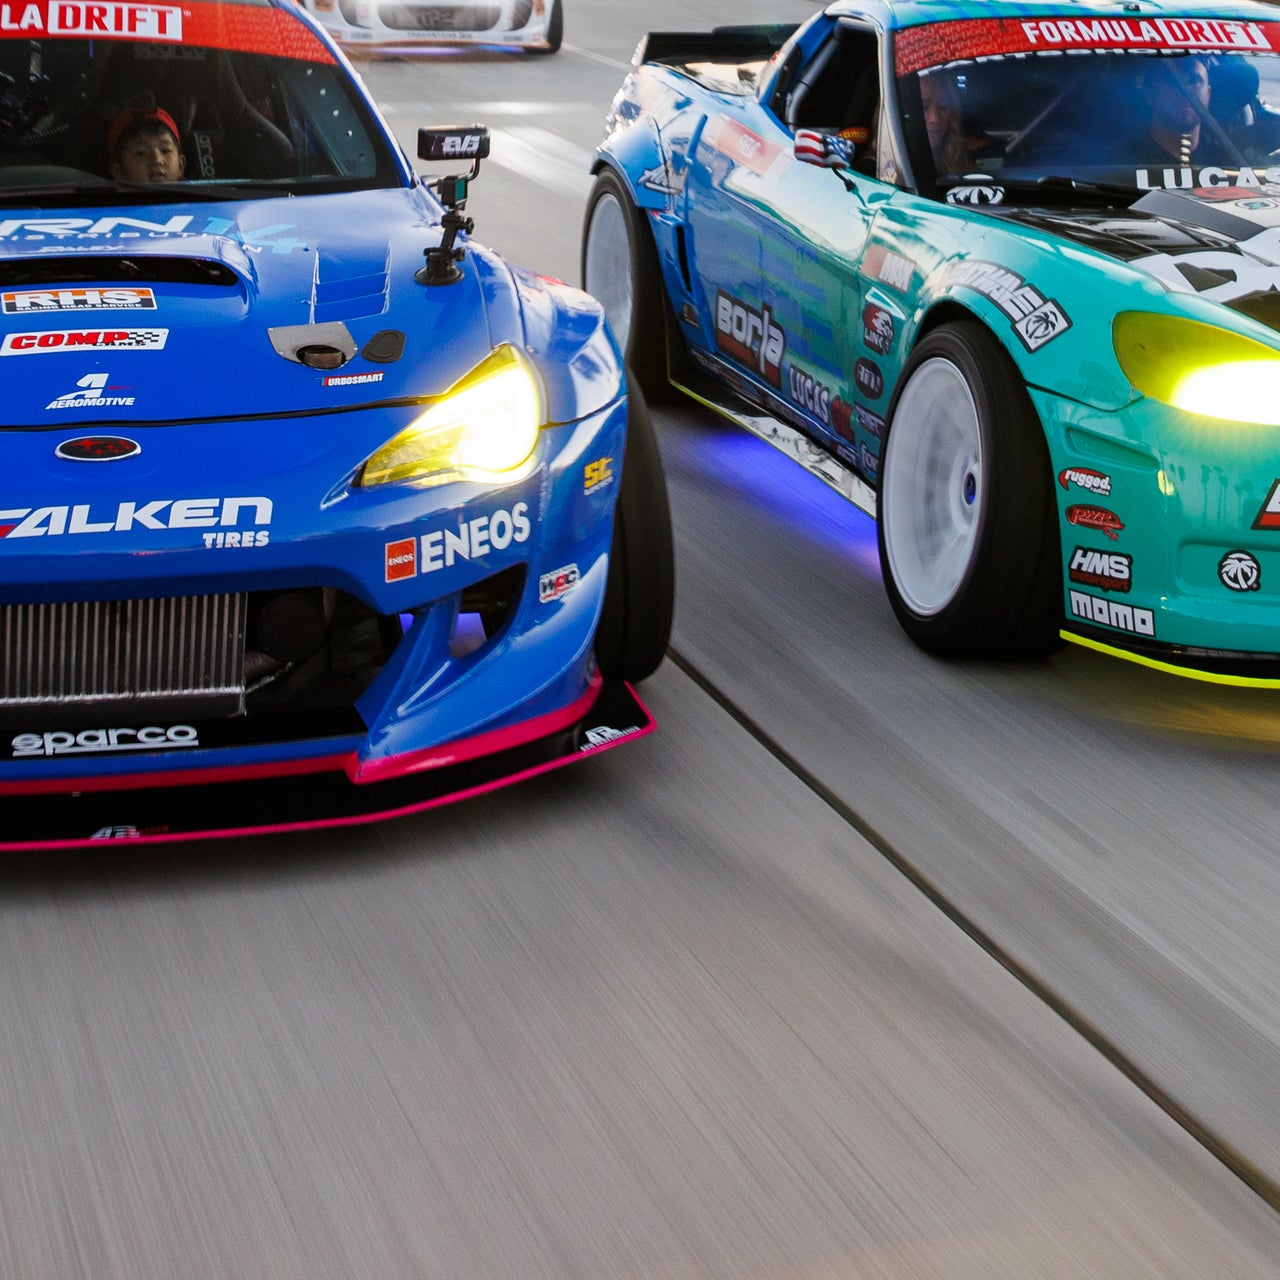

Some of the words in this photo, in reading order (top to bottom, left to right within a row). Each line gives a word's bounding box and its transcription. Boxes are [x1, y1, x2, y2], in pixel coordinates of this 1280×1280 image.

[48, 0, 183, 40] DRIFT
[1021, 20, 1162, 44] FORMULA
[1154, 19, 1272, 49] DRIFT
[202, 216, 308, 255] 14
[13, 290, 143, 308] RHS
[10, 331, 130, 351] COMP
[312, 372, 385, 388] TURBOSMART
[45, 397, 136, 410] AEROMOTIVE
[790, 366, 831, 426] LUCAS
[202, 531, 270, 549] TIRES
[388, 552, 415, 566] ENEOS
[420, 502, 532, 574] ENEOS
[1070, 549, 1131, 580] HMS
[11, 723, 199, 757] sparco
